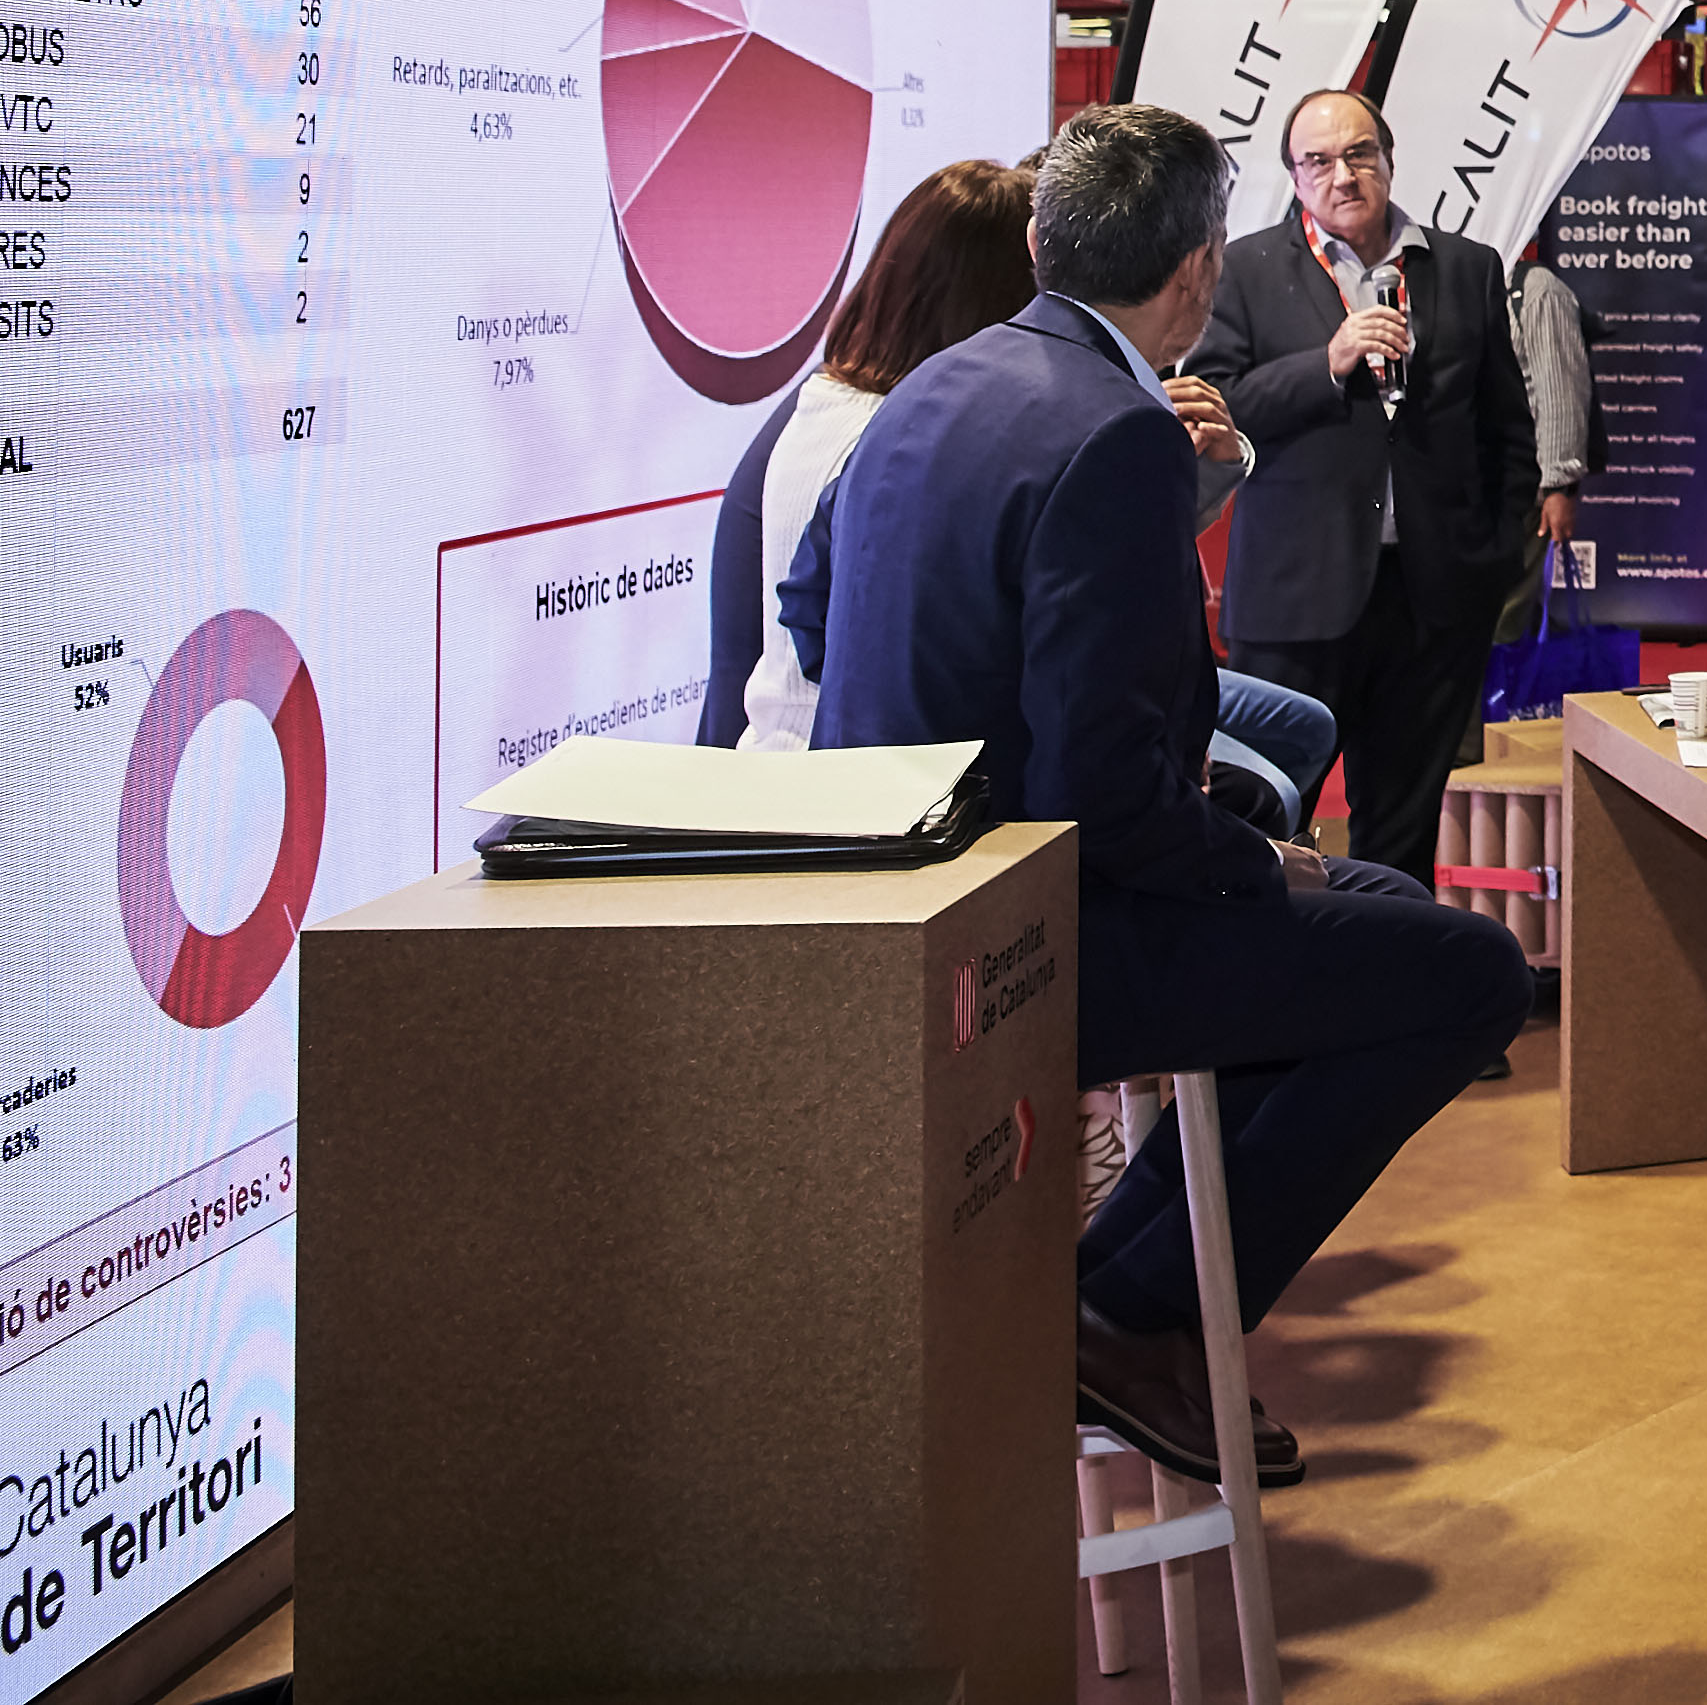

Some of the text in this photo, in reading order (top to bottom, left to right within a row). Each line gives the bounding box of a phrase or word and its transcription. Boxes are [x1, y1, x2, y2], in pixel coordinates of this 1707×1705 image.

[297, 52, 320, 86] 30
[393, 55, 583, 101] Retards, paralitzacions, etc.
[1217, 21, 1282, 196] ALIT
[296, 113, 317, 145] 21
[470, 111, 513, 143] 4,63%
[299, 173, 311, 205] 9
[1559, 195, 1622, 216] Book
[297, 230, 310, 263] 2
[1557, 221, 1691, 243] easier than
[1556, 248, 1694, 270] ever before
[296, 291, 308, 324] 2
[456, 309, 569, 347] Danys o pèrdues
[492, 356, 535, 392] 7,97%
[282, 406, 316, 441] 627
[536, 554, 694, 622] Històric de dades
[60, 633, 124, 670] Usuaris
[74, 678, 111, 713] 52%
[497, 726, 559, 768] Registre
[651, 685, 667, 715] de
[982, 915, 1046, 990] Generalitat
[981, 955, 1056, 1036] de Catalunya
[1, 1122, 41, 1163] 63%
[35, 1276, 72, 1324] de
[80, 1170, 271, 1299] controvèrsies:
[0, 1376, 212, 1558] Catalunya
[1, 1415, 263, 1656] de Territori
